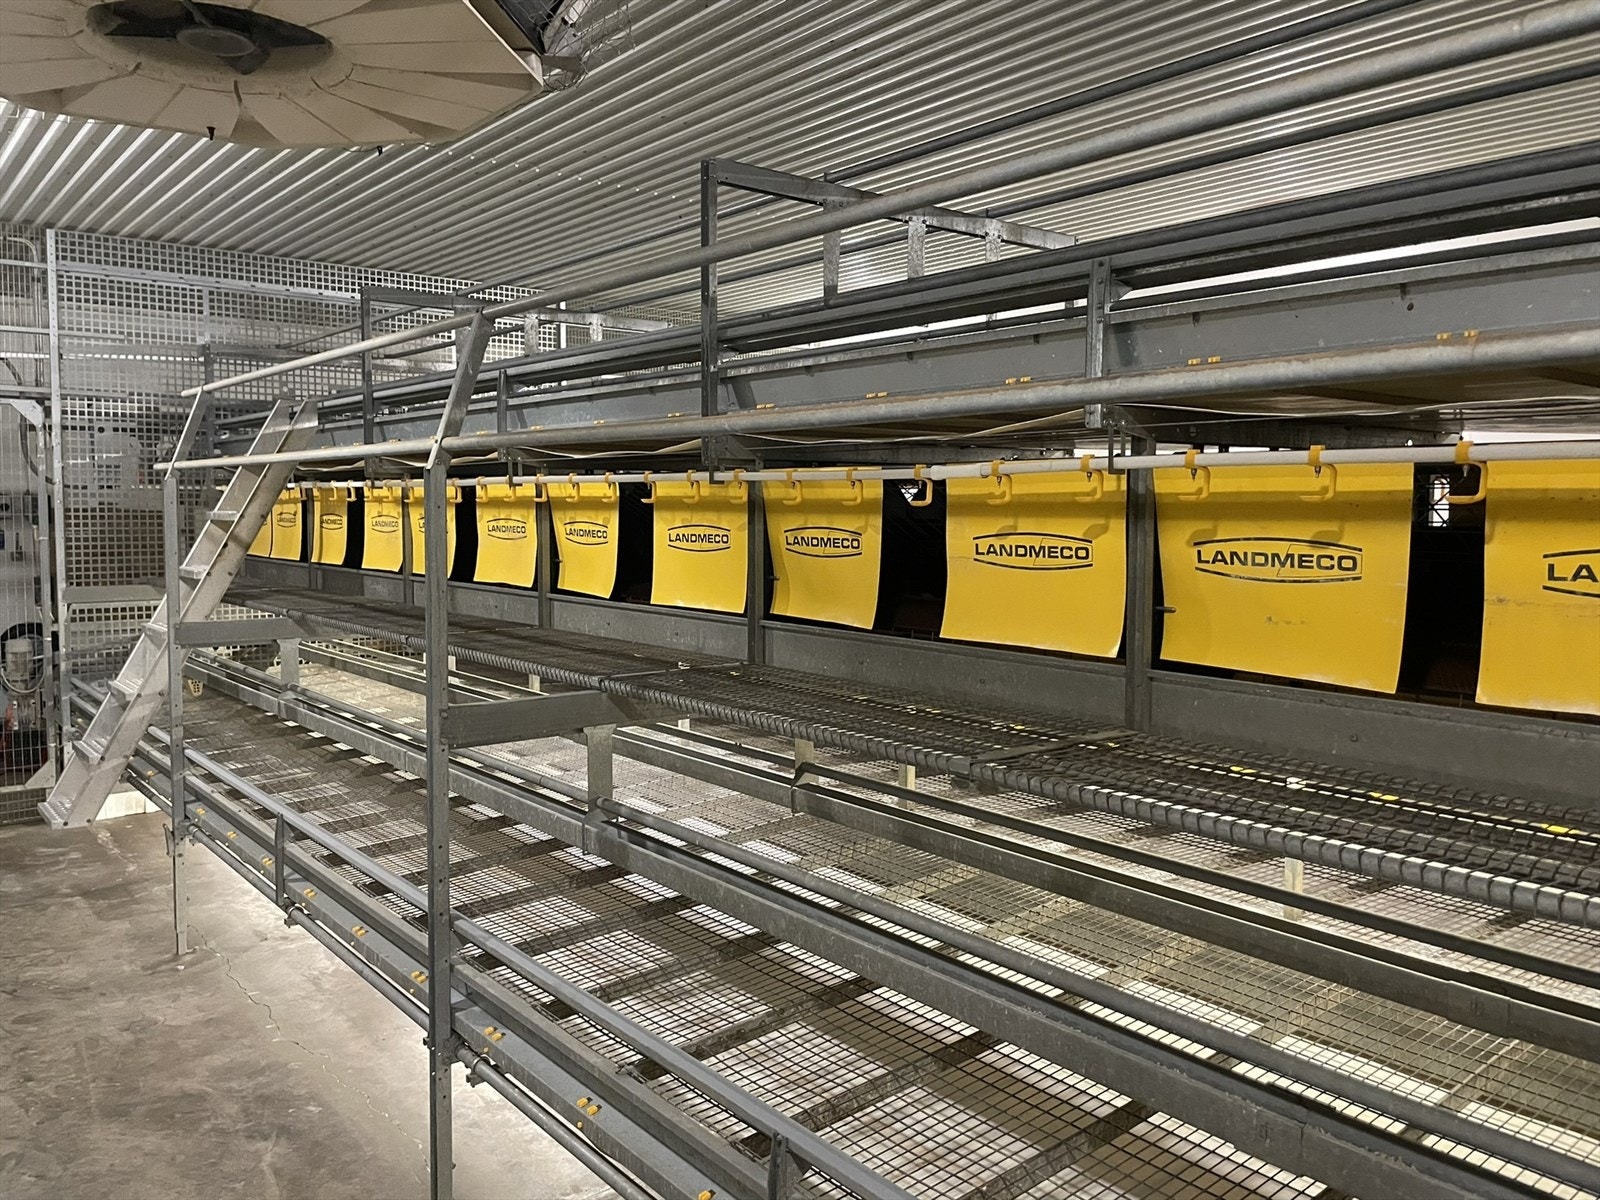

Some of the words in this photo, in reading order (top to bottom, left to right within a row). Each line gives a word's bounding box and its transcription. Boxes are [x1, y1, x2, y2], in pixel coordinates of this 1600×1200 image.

[487, 524, 526, 534] LANDMECO
[564, 527, 608, 539] LANDMECO
[668, 533, 729, 544] LANDMECO
[785, 535, 860, 550] LANDMECO
[975, 543, 1090, 560] LANDMECO
[1197, 549, 1358, 572] LANDMECO
